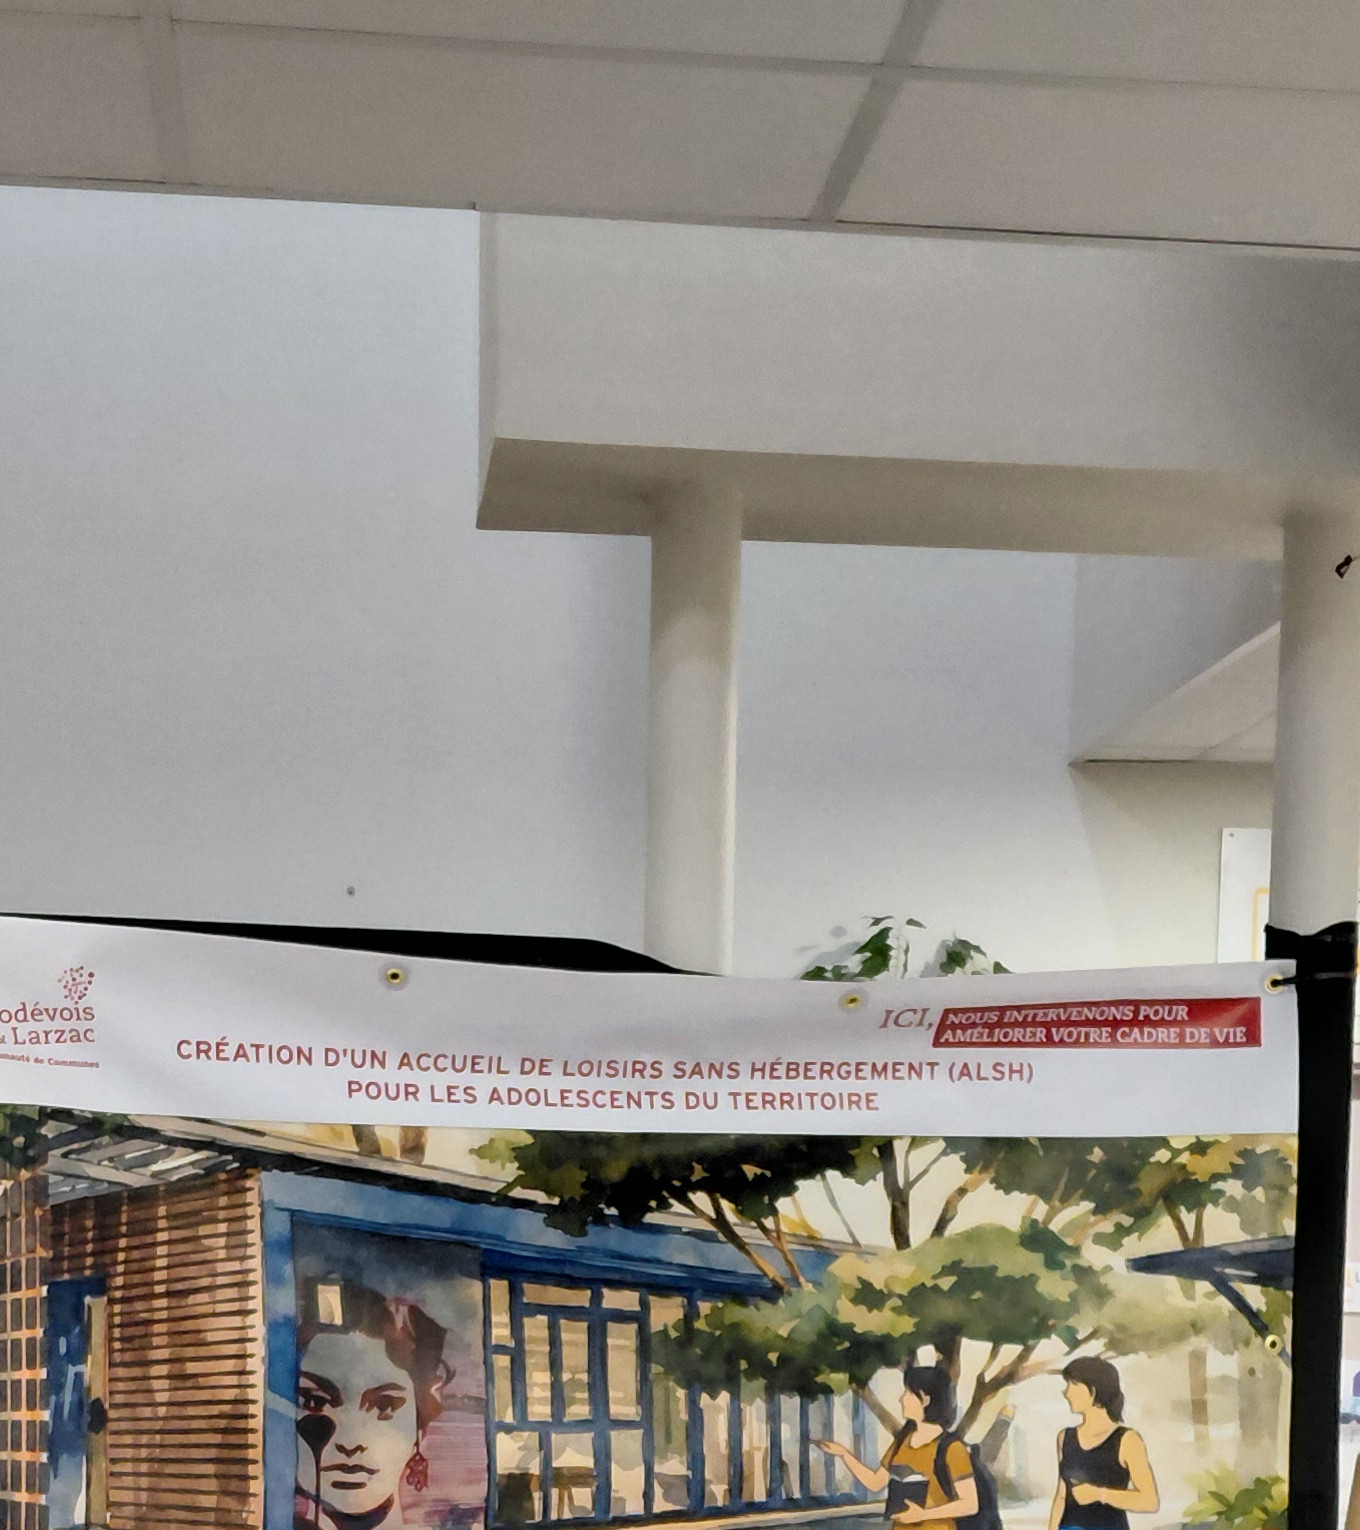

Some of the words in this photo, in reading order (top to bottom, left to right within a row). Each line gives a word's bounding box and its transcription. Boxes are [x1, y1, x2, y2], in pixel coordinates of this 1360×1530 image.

[879, 1007, 933, 1031] ICI,
[945, 1010, 998, 1025] NOUS
[1002, 1005, 1134, 1023] INTERVENONS
[1137, 1005, 1188, 1021] POUR
[11, 1026, 96, 1046] Larzac
[940, 1024, 1047, 1043] AMÉLIORER
[1051, 1026, 1112, 1043] VOTRE
[1116, 1026, 1179, 1043] CADRE
[1185, 1027, 1211, 1043] DE
[1216, 1026, 1246, 1043] VIE
[177, 1036, 313, 1066] CRÉATION
[324, 1047, 387, 1070] D'UN
[397, 1052, 511, 1075] ACCUEIL
[520, 1057, 553, 1076] DE
[562, 1059, 664, 1080] LOISIRS
[673, 1060, 741, 1080] SANS
[750, 1056, 940, 1082] HÉBERGEMENT
[948, 1061, 1034, 1084] (ALSH)
[347, 1080, 421, 1101] POUR
[430, 1084, 478, 1104] LES
[488, 1086, 675, 1110] ADOLESCENTS
[685, 1090, 718, 1110] DU
[730, 1091, 879, 1111] TERRITOIRE
